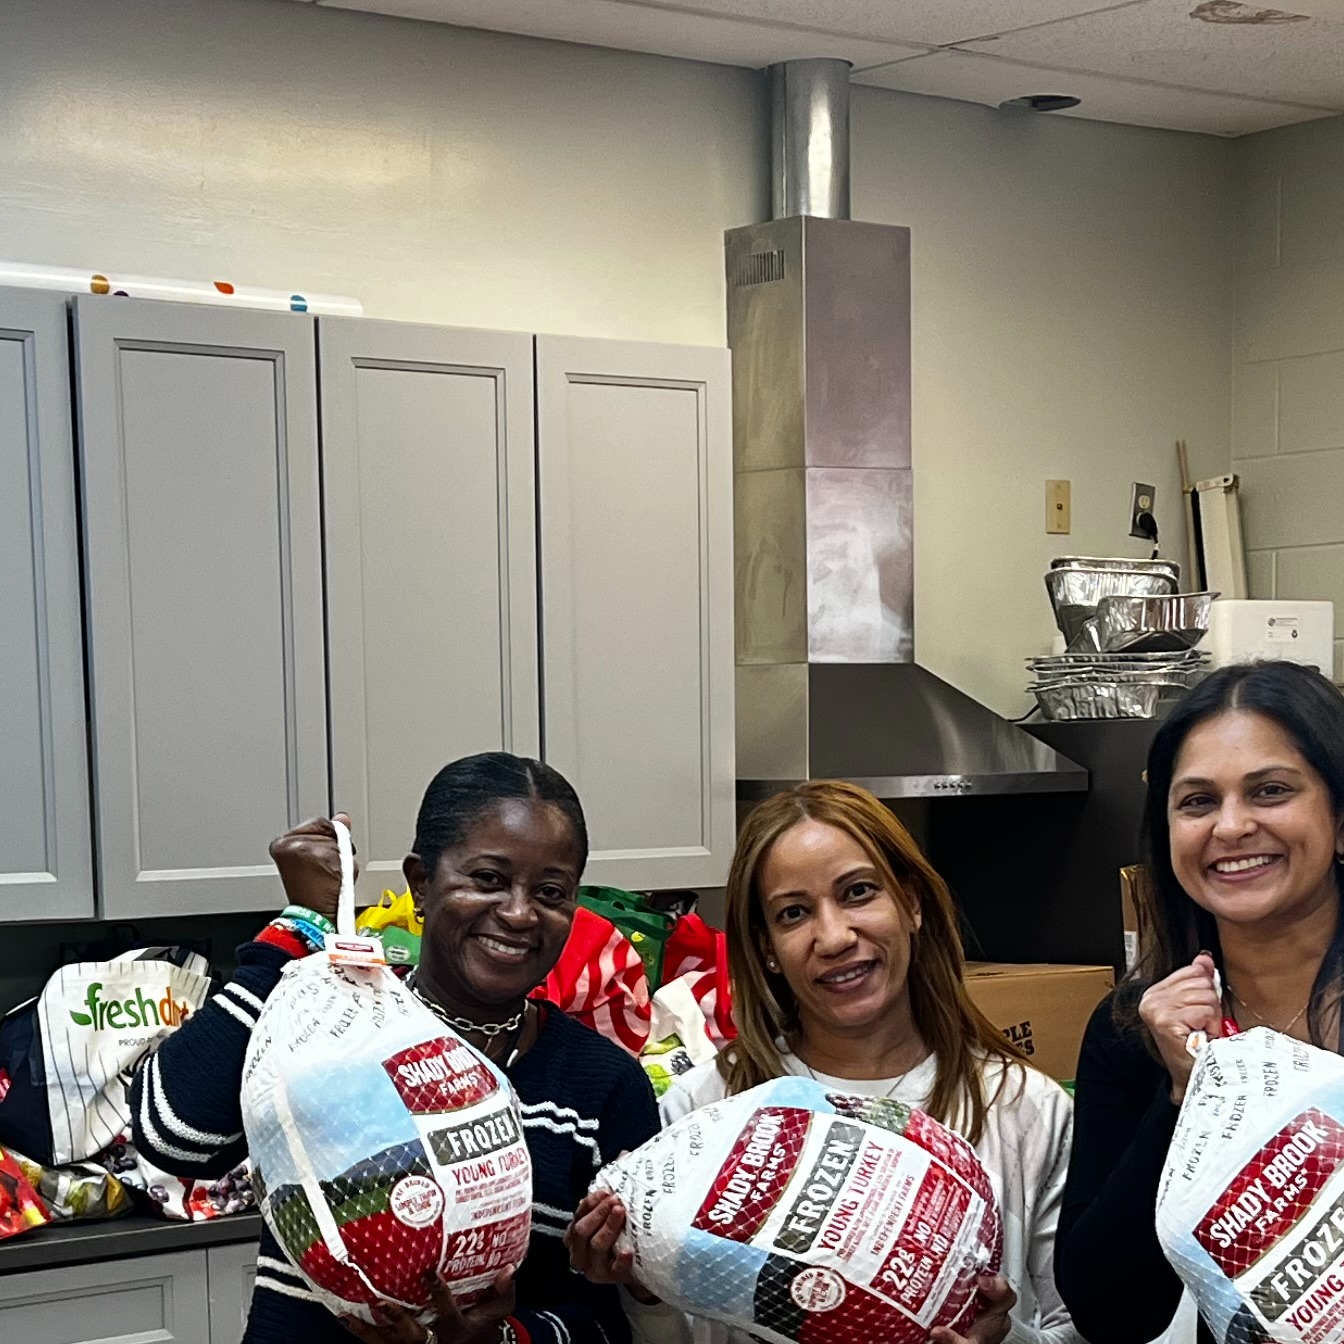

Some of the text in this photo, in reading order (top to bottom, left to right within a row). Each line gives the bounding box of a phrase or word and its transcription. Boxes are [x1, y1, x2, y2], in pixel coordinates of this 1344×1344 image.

[397, 1053, 452, 1088] SHADY
[438, 1073, 480, 1098] FARMS
[452, 1160, 496, 1187] YOUNG
[707, 1112, 786, 1226] SHADY BROOK
[749, 1141, 787, 1203] FARMS
[788, 1138, 857, 1235] FROZEN
[817, 1199, 861, 1251] YOUNG
[848, 1140, 886, 1195] TURKEY
[1209, 1118, 1330, 1249] SHADY BROOK
[641, 1188, 658, 1238] FROZEN
[913, 1219, 933, 1246] NO
[1255, 1172, 1309, 1234] FARMS
